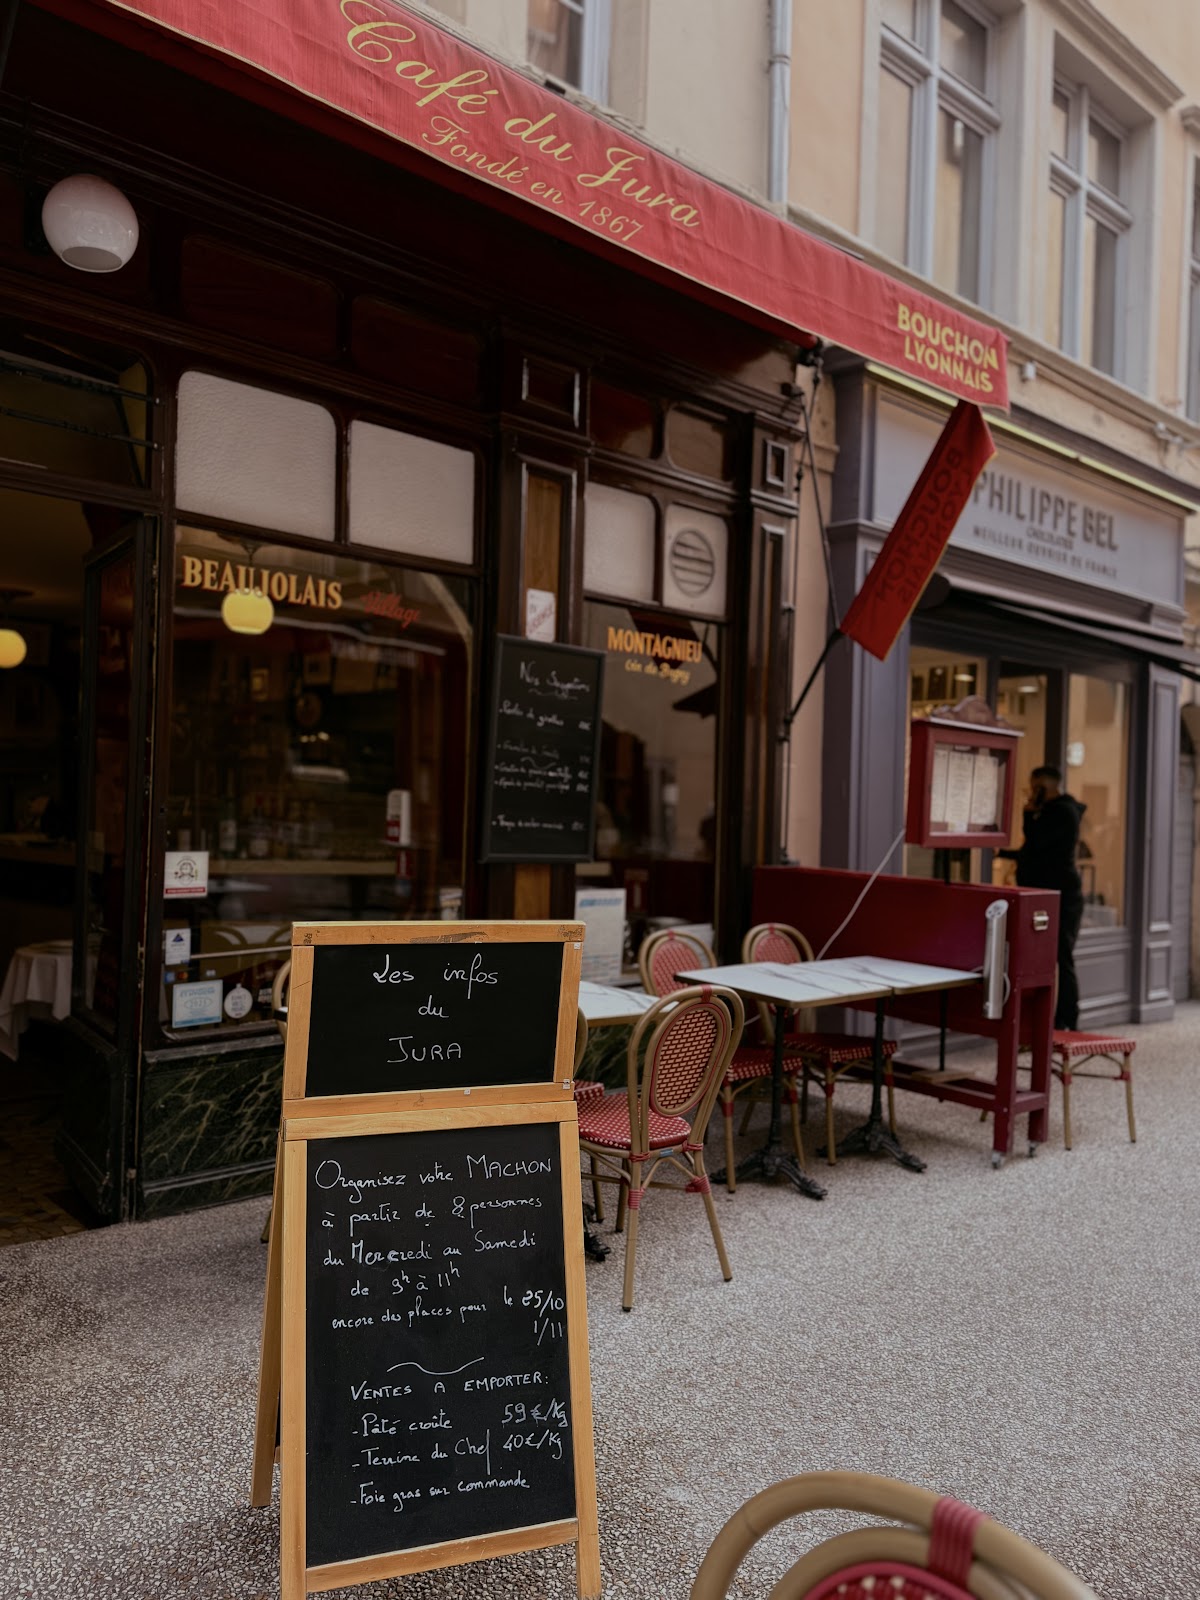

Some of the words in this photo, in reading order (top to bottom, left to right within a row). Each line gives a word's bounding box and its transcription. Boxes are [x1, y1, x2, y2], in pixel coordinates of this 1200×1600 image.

[340, 0, 498, 114] Café
[504, 112, 573, 161] du
[577, 147, 700, 227] Jura
[422, 116, 529, 184] Fondé
[530, 181, 563, 204] en
[579, 201, 644, 241] 1867
[898, 303, 998, 370] BOUCHON
[904, 336, 994, 393] LYONNAIS
[973, 471, 1077, 537] PHILIPPE
[1082, 506, 1118, 551] BEL
[181, 555, 342, 609] BEAUJOLAIS
[607, 626, 703, 663] MONTAGNIEU
[373, 954, 414, 983] Les
[443, 953, 499, 999] infos
[418, 995, 449, 1018] du
[387, 1036, 462, 1063] JURA
[315, 1160, 406, 1203] Organisez
[419, 1162, 453, 1184] votre
[466, 1154, 551, 1179] MACHON
[322, 1211, 335, 1228] à
[350, 1203, 401, 1237] partir
[415, 1203, 435, 1218] de
[452, 1196, 465, 1219] 8
[470, 1197, 542, 1228] personnes
[323, 1250, 344, 1267] du
[351, 1240, 432, 1264] Mercredi
[442, 1246, 462, 1256] au
[474, 1229, 536, 1252] Samedi
[350, 1280, 369, 1296] de
[392, 1270, 410, 1295] 9h
[416, 1275, 428, 1291] à
[438, 1261, 461, 1287] 11h
[332, 1317, 374, 1330] encore
[381, 1309, 401, 1323] des
[408, 1295, 452, 1328] places
[459, 1303, 487, 1324] pour
[503, 1286, 513, 1307] le
[533, 1317, 563, 1346] 1/11
[350, 1380, 412, 1400] VENTES
[434, 1382, 446, 1394] A
[409, 1409, 452, 1431] croûte
[432, 1443, 448, 1460] du
[455, 1428, 490, 1475] Chef
[393, 1489, 421, 1513] gras
[430, 1487, 450, 1497] sur
[457, 1470, 530, 1493] commande
